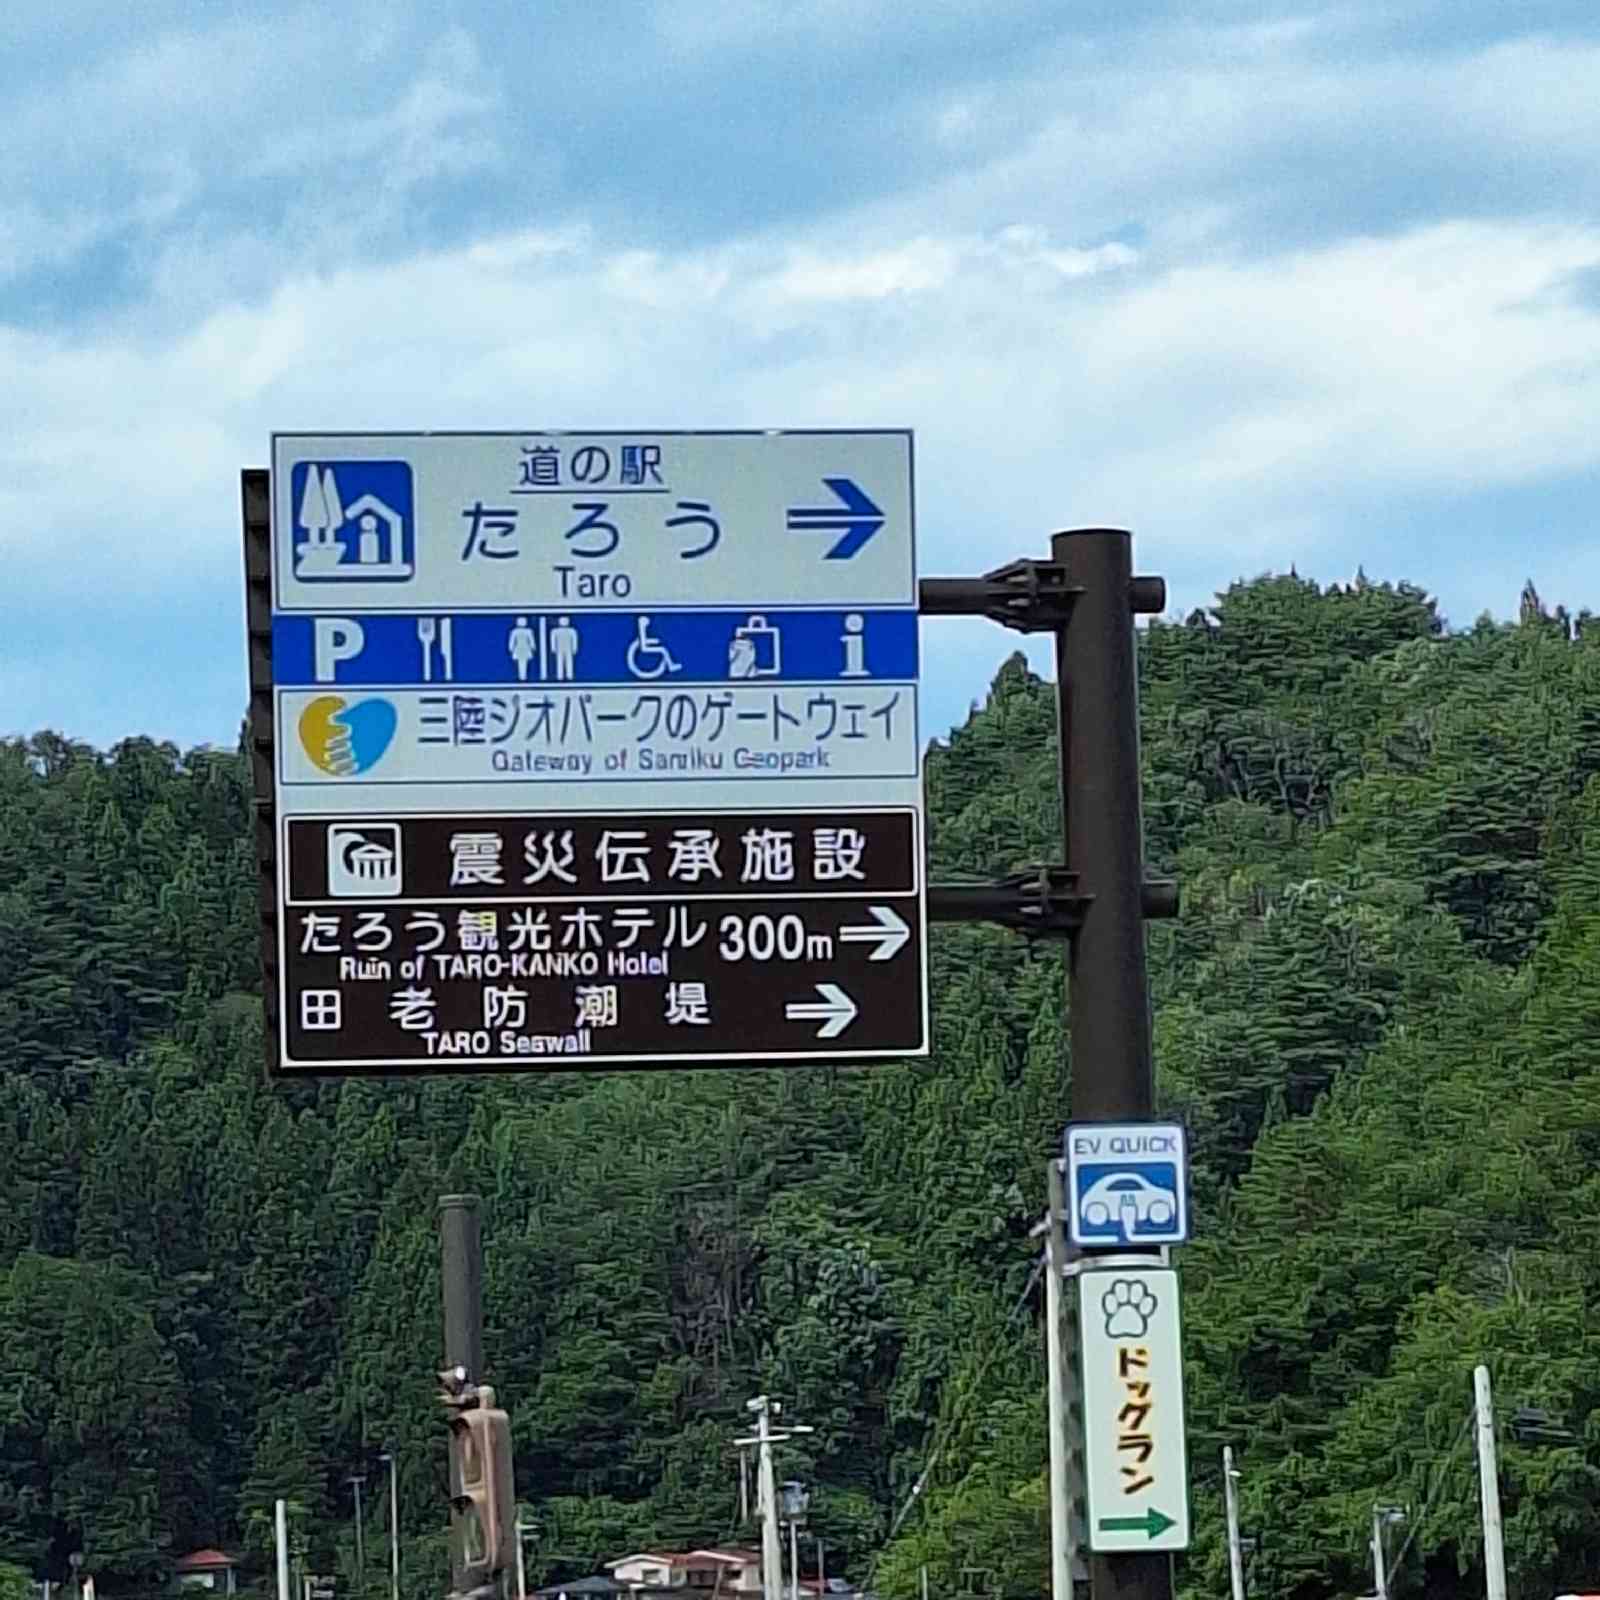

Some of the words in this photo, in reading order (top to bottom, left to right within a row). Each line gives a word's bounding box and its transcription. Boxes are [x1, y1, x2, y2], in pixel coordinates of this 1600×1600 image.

[519, 445, 664, 486] 道の駅
[461, 501, 721, 561] たろう
[553, 566, 632, 598] Taro
[314, 618, 364, 682] P
[491, 750, 593, 775] Gateway
[604, 748, 627, 771] of
[733, 747, 830, 773] Geopark
[449, 827, 867, 885] 震災伝承施設
[301, 906, 707, 954] たろう観光ホテル
[719, 914, 834, 962] 300m
[340, 956, 391, 981] Ruin
[400, 954, 426, 981] of
[432, 951, 599, 980] TARO-KANKO
[607, 950, 669, 976] Hotel
[301, 981, 712, 1031] 田老防潮堤
[420, 1031, 491, 1056] TARO
[500, 1028, 592, 1054] Seawall
[1074, 1138, 1102, 1154] EV
[1110, 1136, 1178, 1154] QUICK
